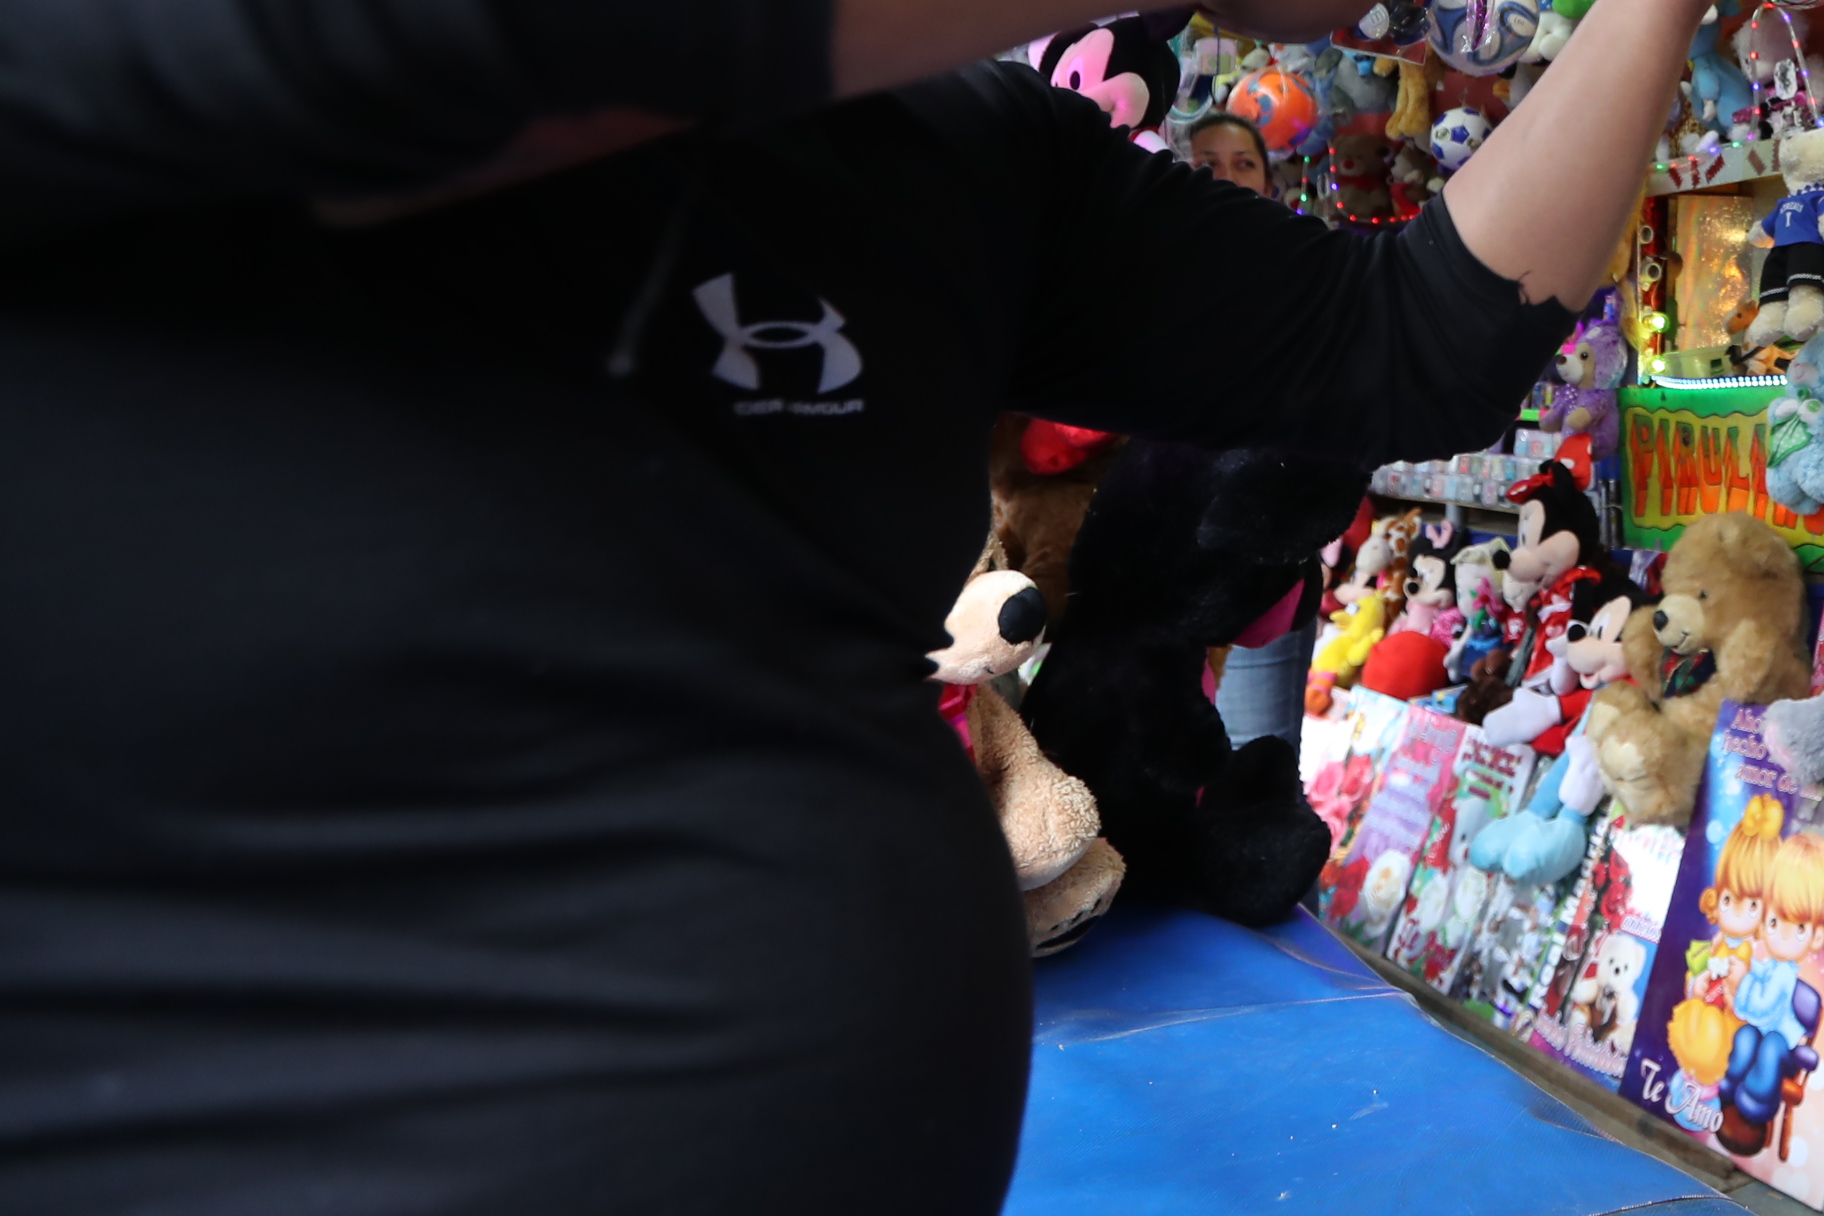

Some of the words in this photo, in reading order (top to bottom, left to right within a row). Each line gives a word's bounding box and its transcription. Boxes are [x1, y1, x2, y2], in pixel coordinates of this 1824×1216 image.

[1722, 729, 1767, 761] hecho
[1735, 764, 1778, 789] amor
[1777, 773, 1799, 795] de
[1529, 932, 1567, 1010] Real
[1640, 1057, 1665, 1103] Te
[1664, 1083, 1725, 1134] Amo
